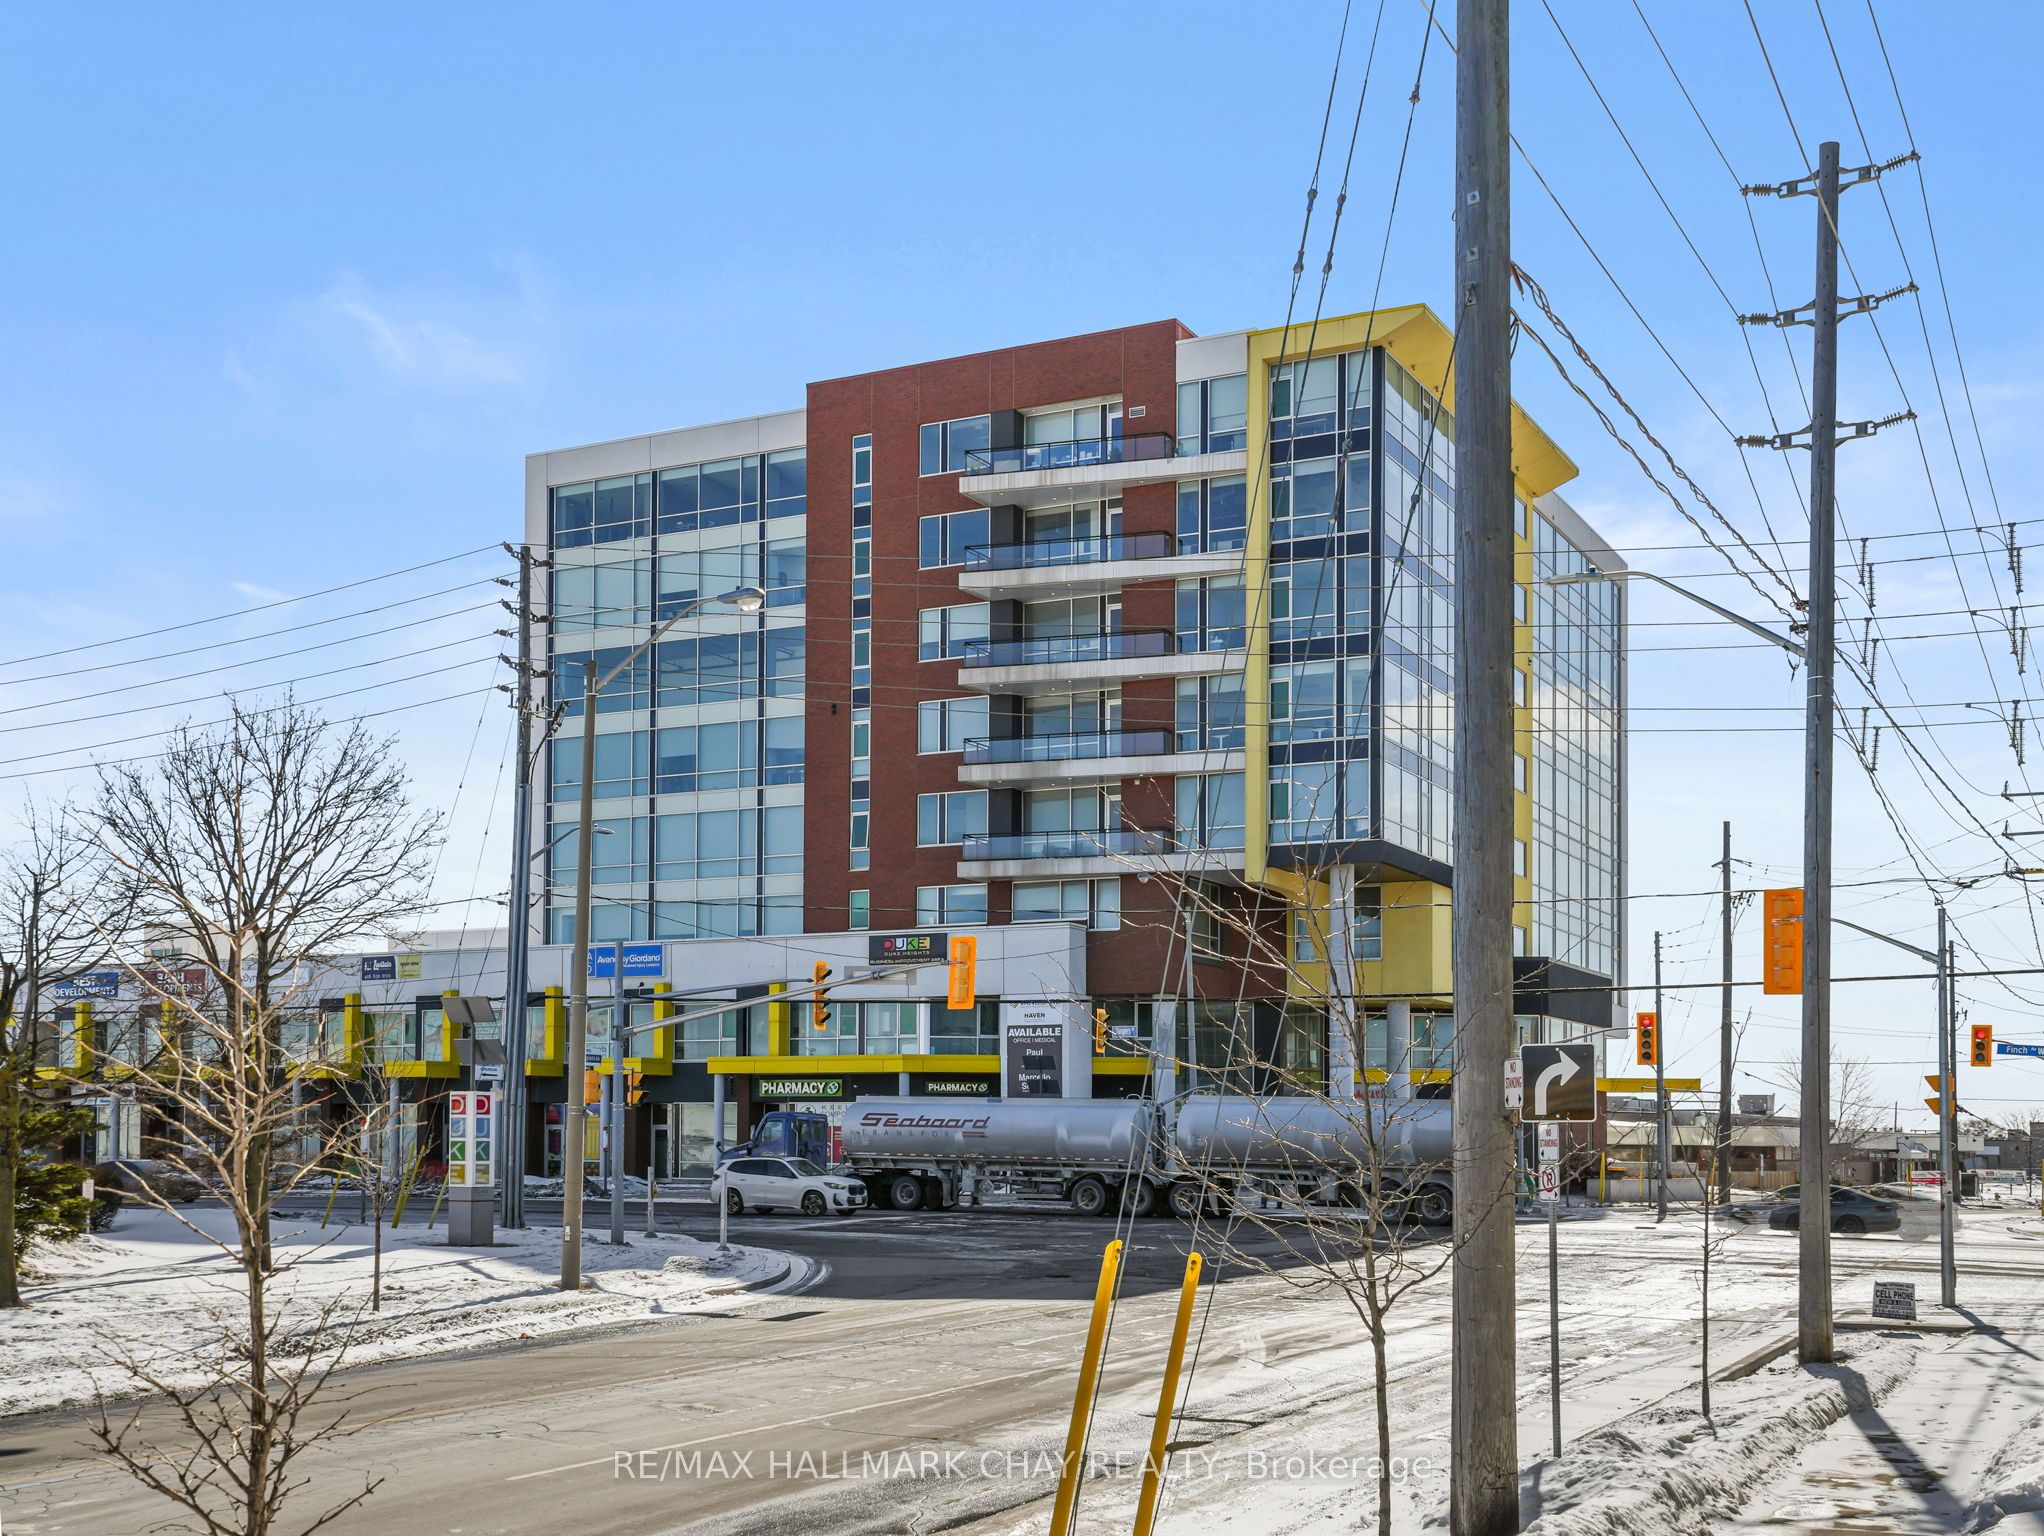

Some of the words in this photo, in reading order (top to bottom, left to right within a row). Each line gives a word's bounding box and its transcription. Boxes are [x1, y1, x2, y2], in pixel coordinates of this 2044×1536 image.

[884, 937, 930, 950] DUKE
[73, 976, 97, 987] BEST
[55, 986, 116, 997] DEVELOPMENTS
[1008, 1027, 1062, 1037] AVAILABLE
[1026, 1048, 1043, 1056] Paul
[2006, 1045, 2028, 1054] Finch
[1509, 1062, 1517, 1073] NO
[761, 1082, 826, 1094] PHARMACY
[928, 1083, 978, 1092] PHARMACY
[1505, 1077, 1522, 1089] STANDING
[860, 1113, 990, 1128] Seaboard
[1545, 1128, 1552, 1137] NO
[1540, 1139, 1558, 1148] STANDING
[1875, 1289, 1892, 1298] CELL
[1893, 1290, 1914, 1301] PHONE
